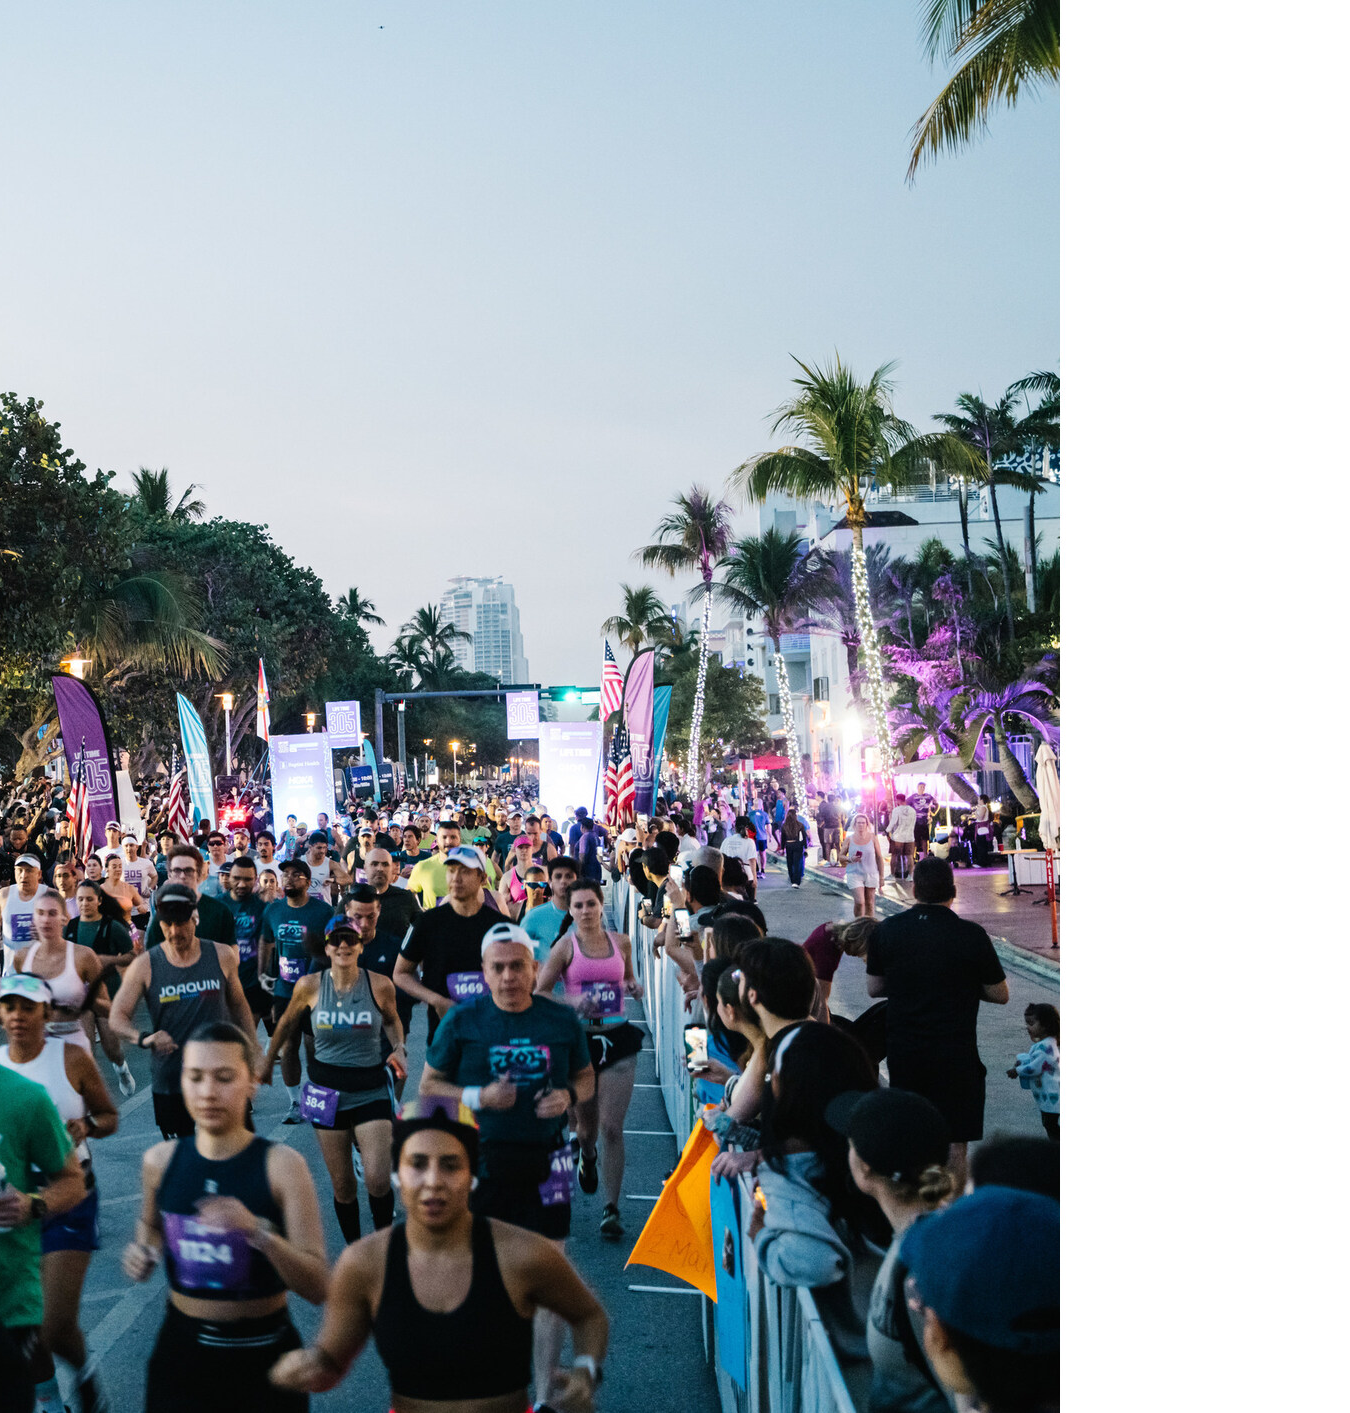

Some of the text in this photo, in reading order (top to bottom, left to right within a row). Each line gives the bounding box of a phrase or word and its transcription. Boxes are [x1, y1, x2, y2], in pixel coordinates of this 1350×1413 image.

[329, 711, 356, 734] 305
[509, 702, 537, 726] 305
[630, 743, 651, 780] 05
[124, 870, 142, 879] 305
[159, 979, 220, 998] JOAQUIN
[455, 982, 483, 995] 1669
[317, 1011, 372, 1025] RINA
[305, 1096, 326, 1111] 584
